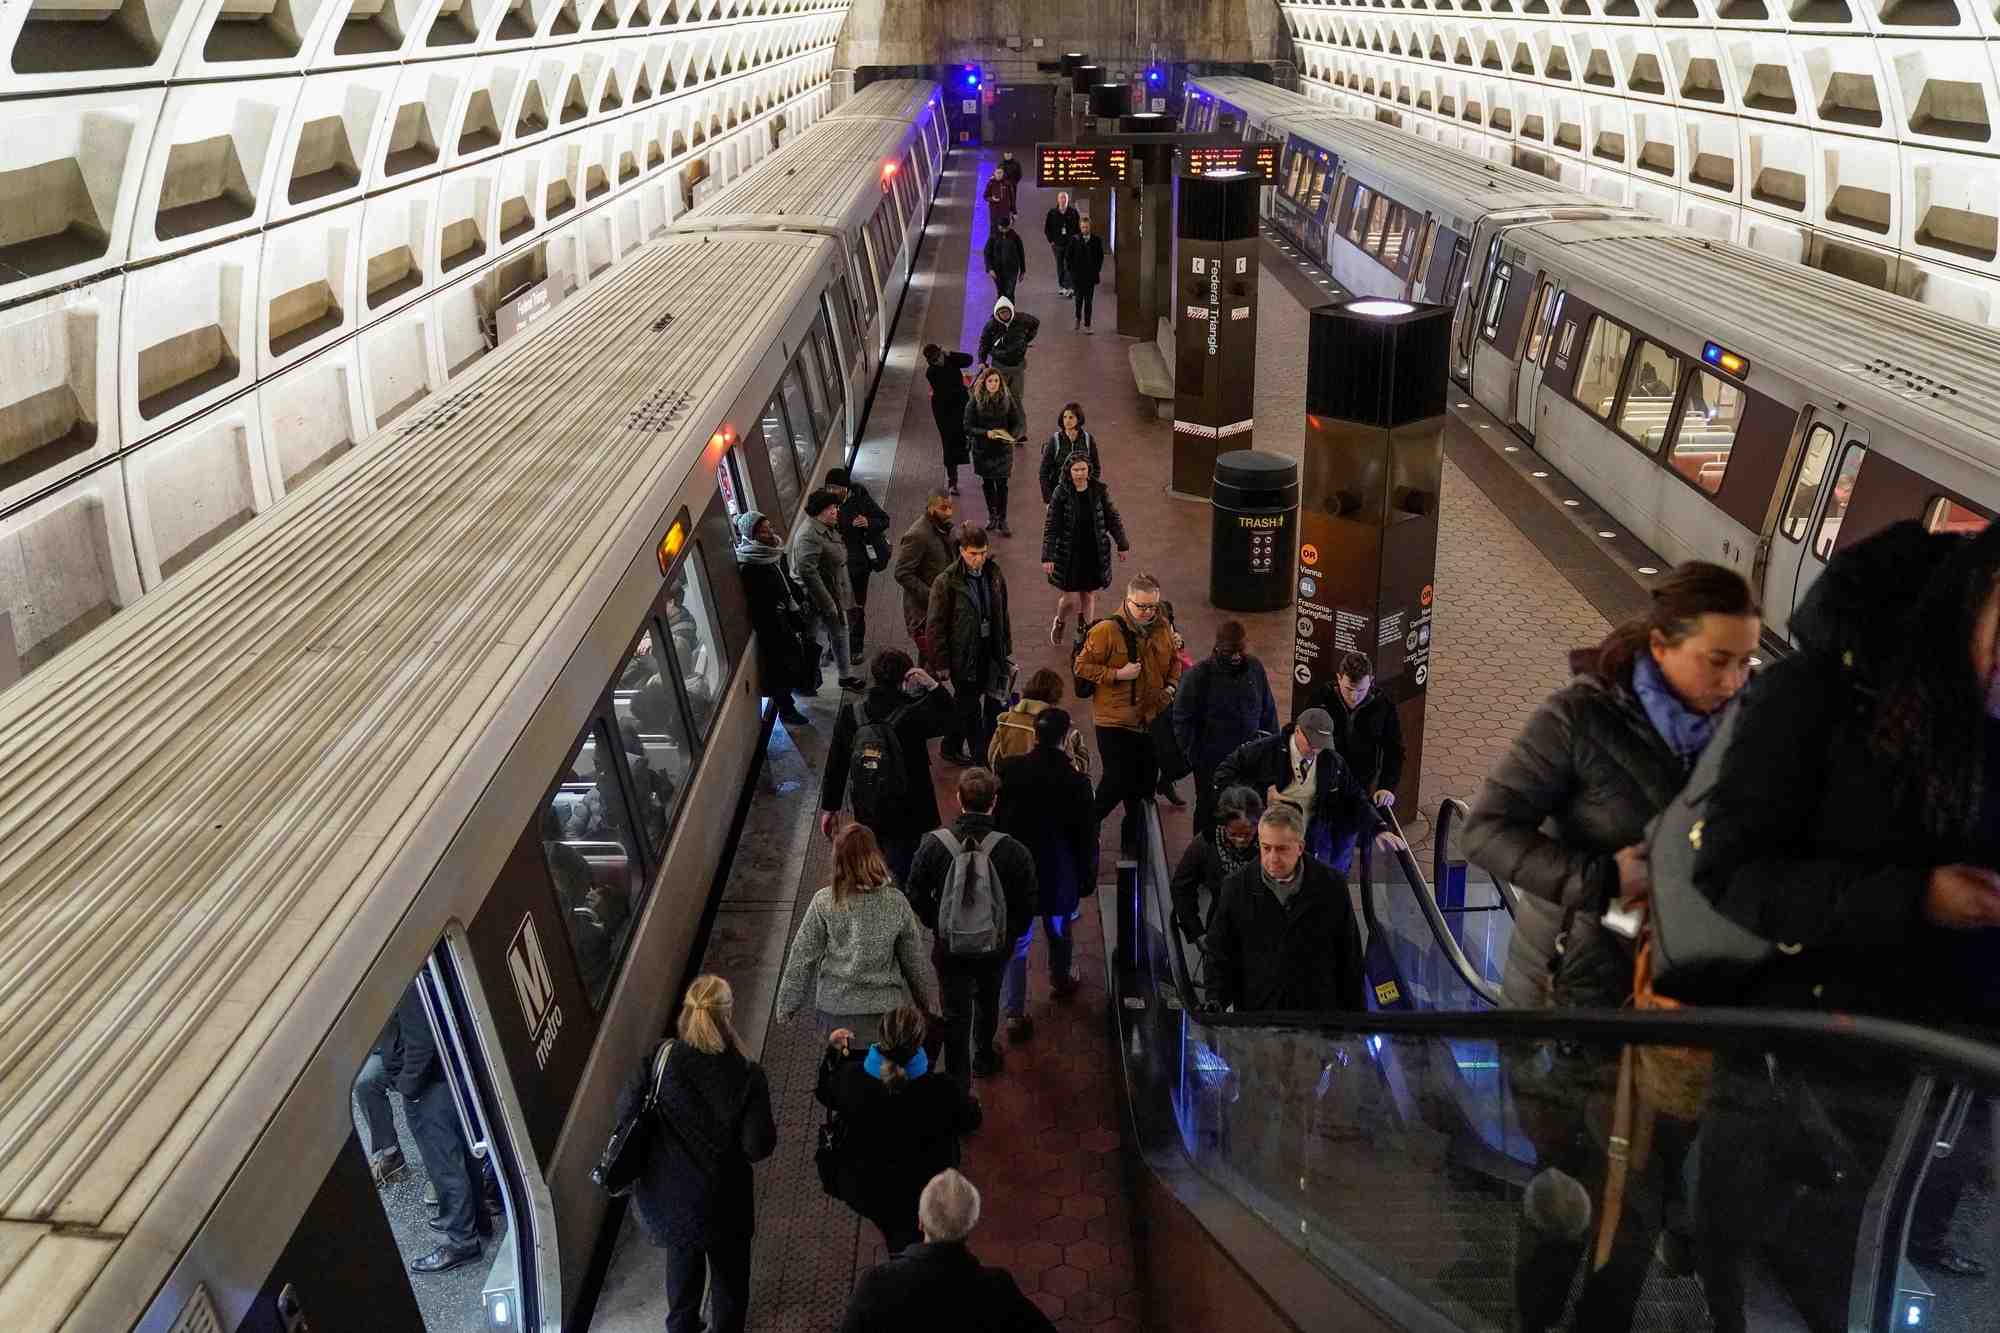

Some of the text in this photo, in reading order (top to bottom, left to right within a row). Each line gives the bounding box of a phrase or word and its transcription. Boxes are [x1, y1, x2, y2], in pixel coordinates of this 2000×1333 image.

[1207, 259, 1221, 355] Federal Triangle
[1239, 517, 1277, 528] TRASH
[1300, 565, 1323, 578] Vienna
[508, 918, 552, 1034] M
[535, 1005, 563, 1071] metro
